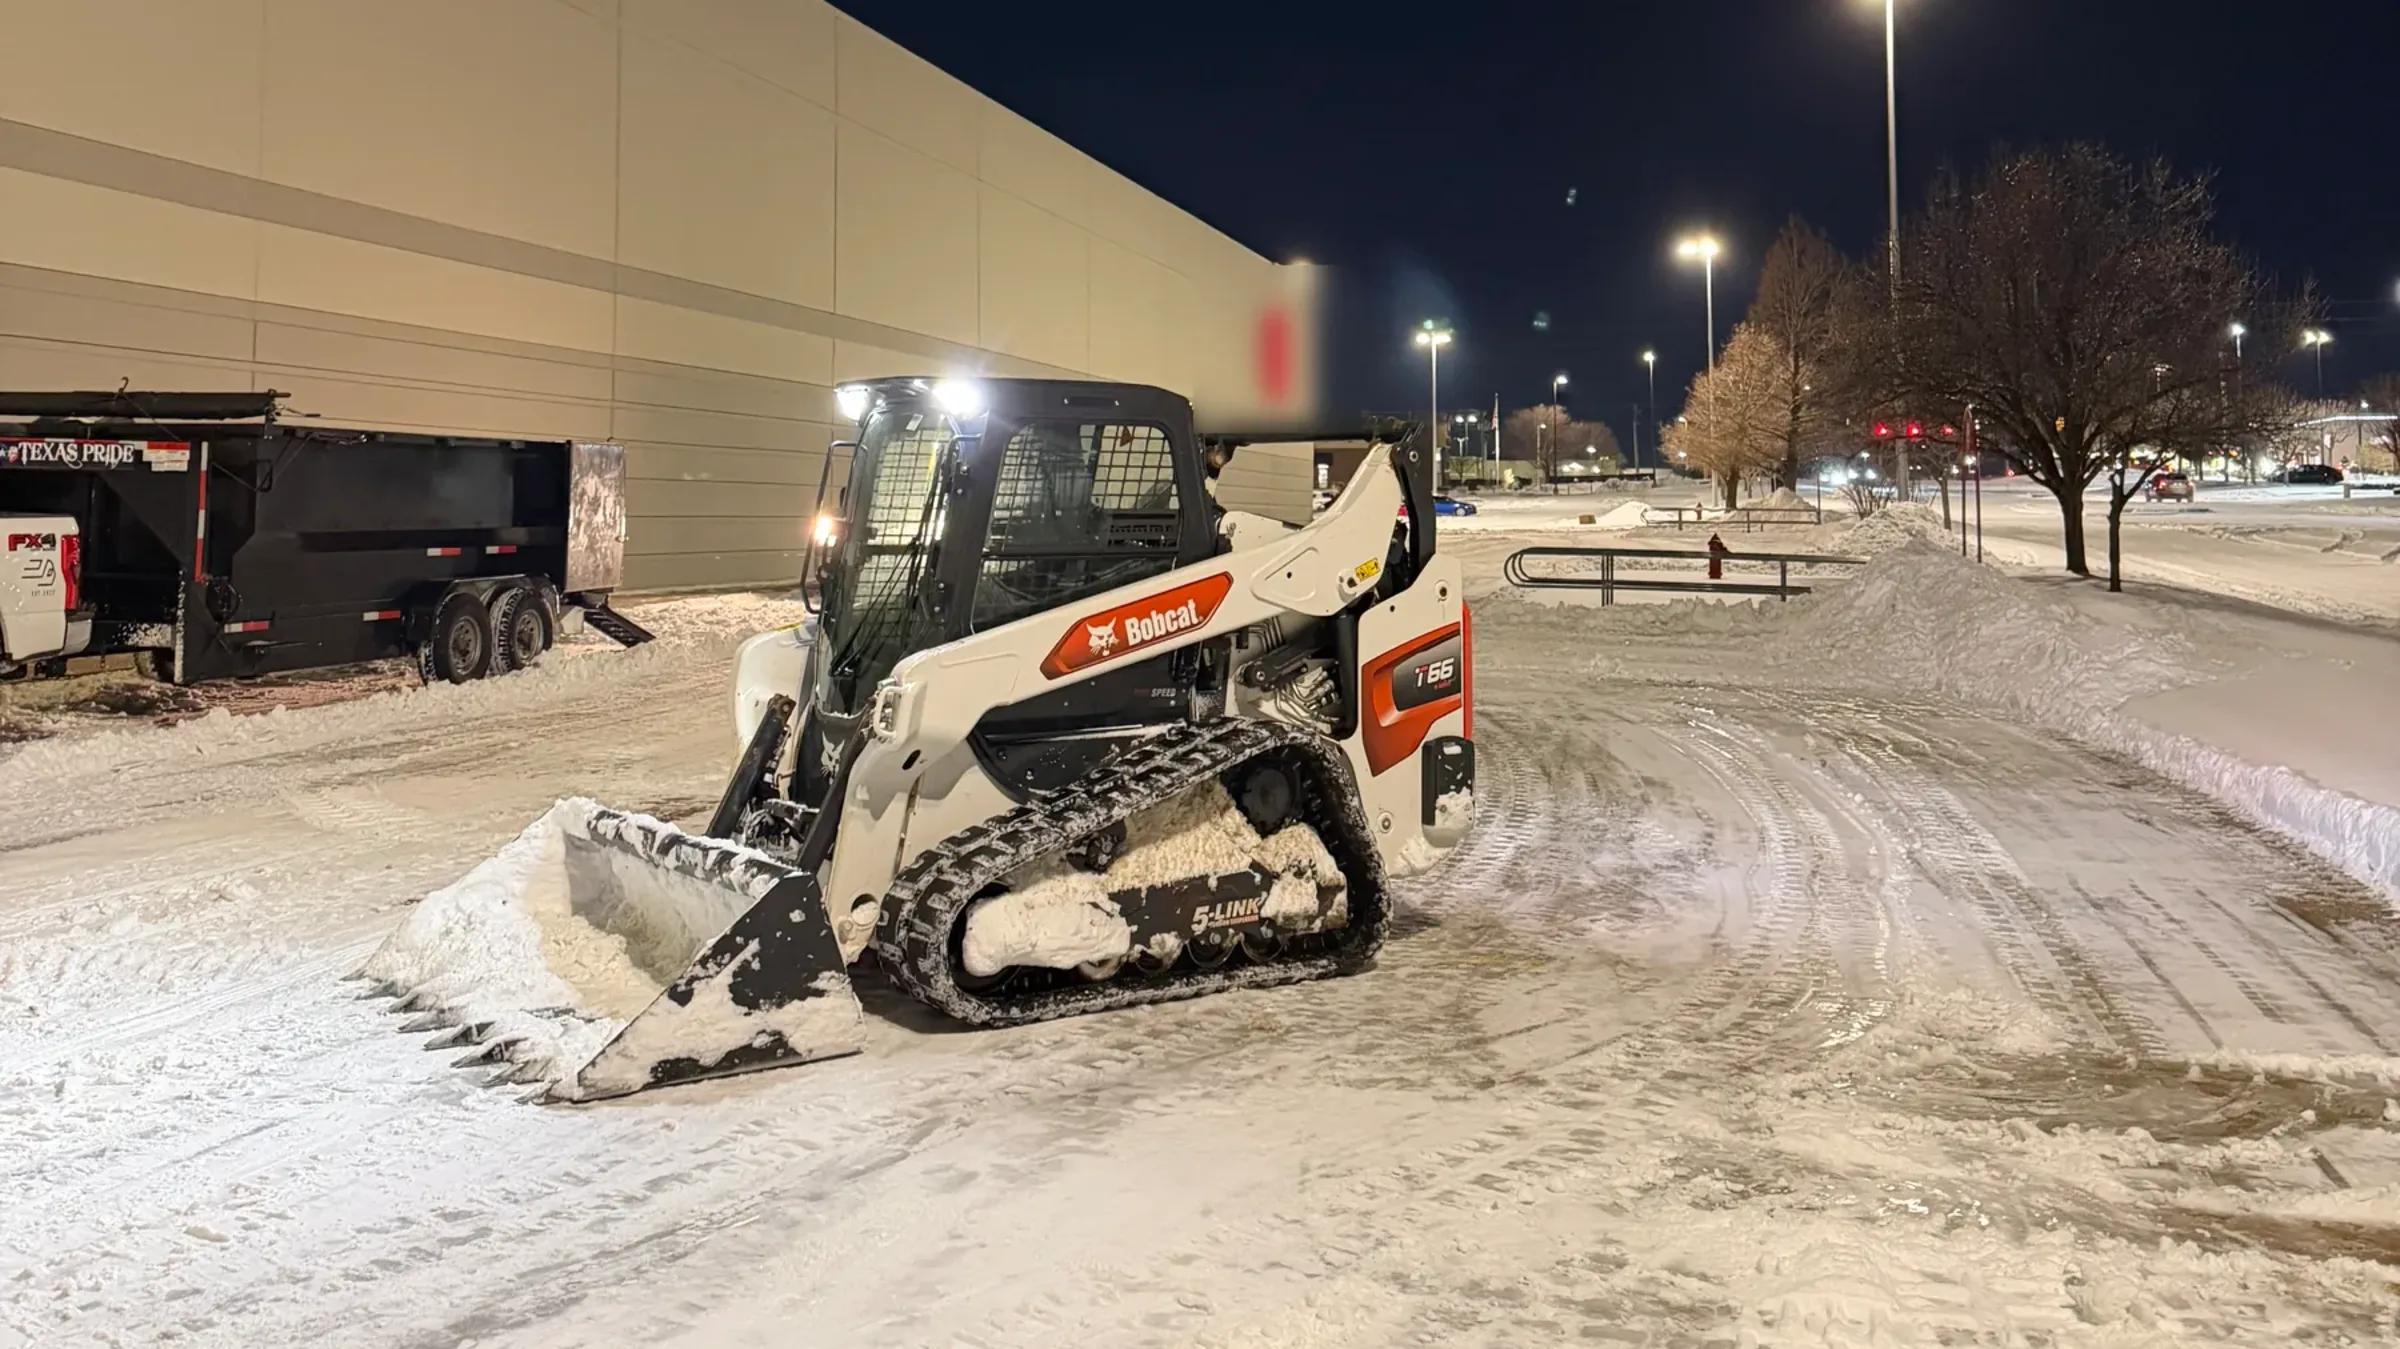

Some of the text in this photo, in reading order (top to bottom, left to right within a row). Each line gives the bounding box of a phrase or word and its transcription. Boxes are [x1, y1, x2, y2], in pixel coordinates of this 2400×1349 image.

[18, 441, 83, 469] TEXAS
[82, 443, 134, 469] PRIDE
[8, 533, 56, 551] FX4
[1124, 598, 1199, 646] Bobcat
[1415, 657, 1454, 687] T66
[1151, 688, 1177, 698] SPEED
